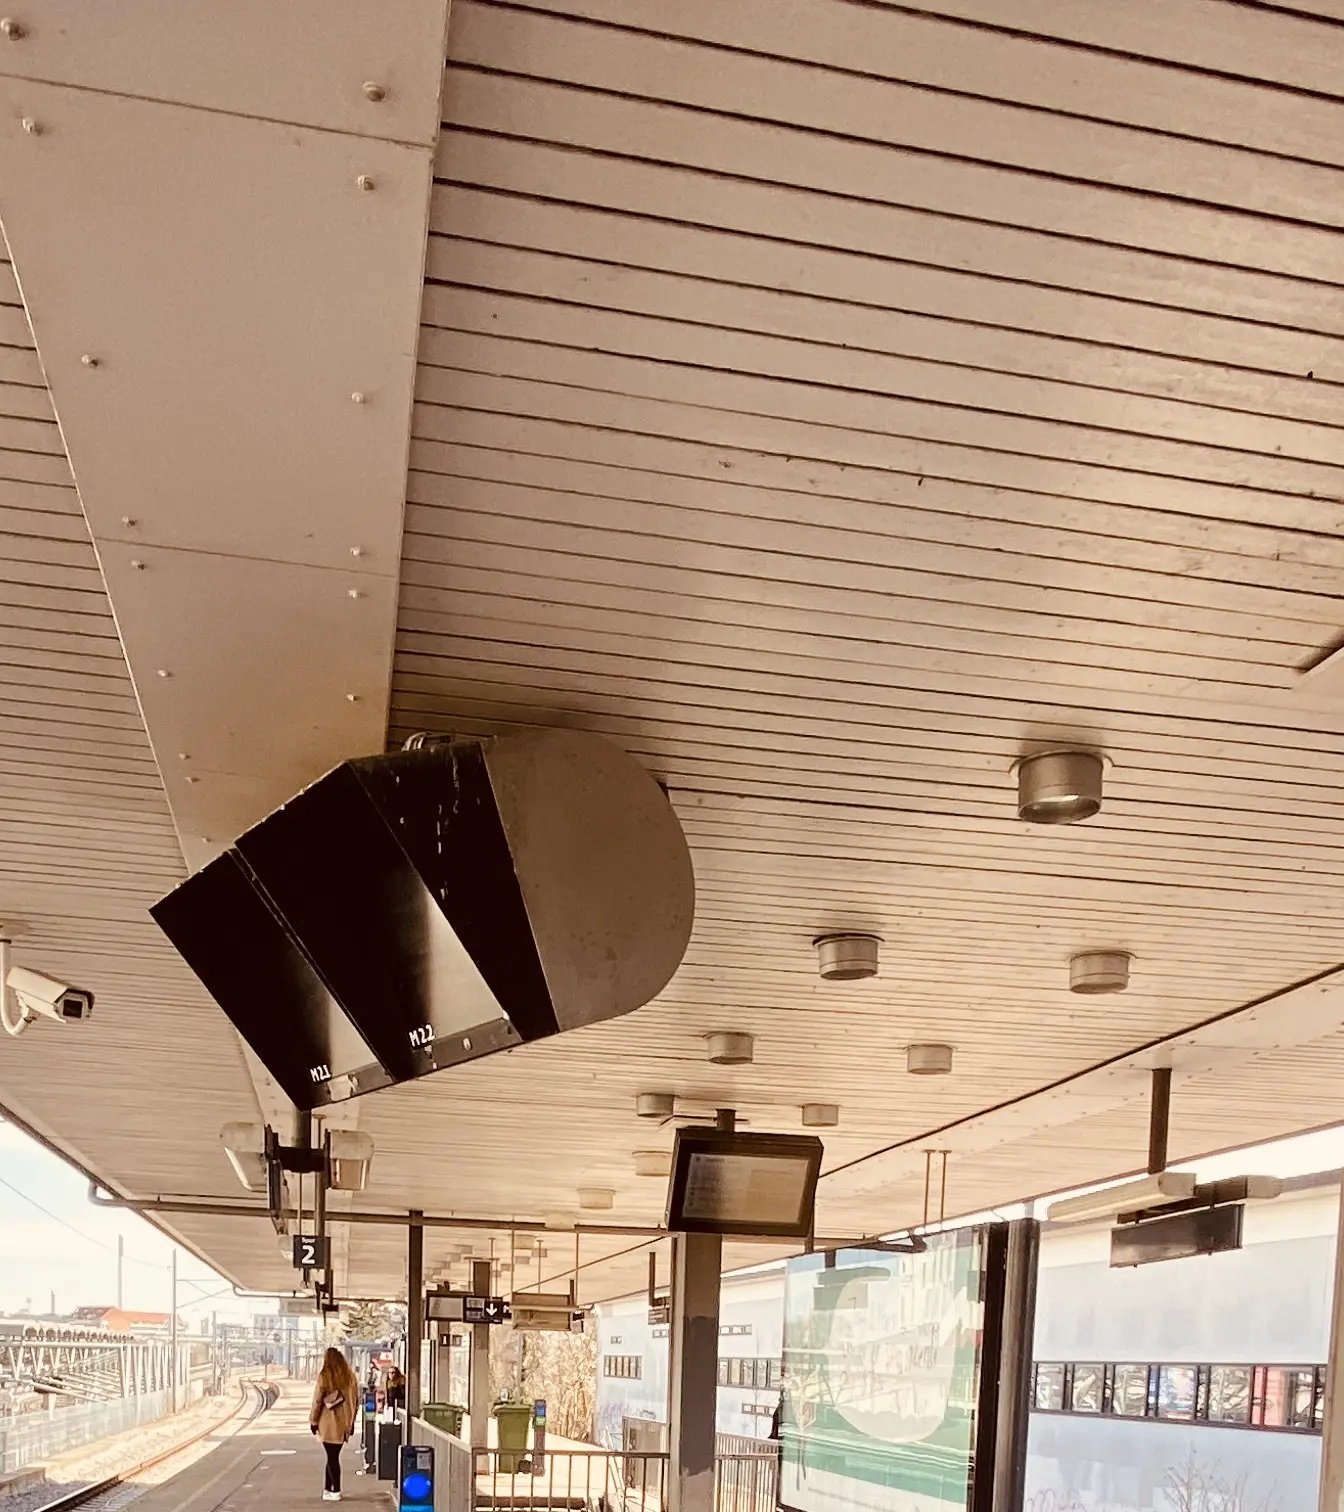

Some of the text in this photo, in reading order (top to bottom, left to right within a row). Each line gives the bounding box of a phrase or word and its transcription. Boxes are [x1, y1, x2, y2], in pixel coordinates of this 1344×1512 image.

[409, 1024, 435, 1047] M22
[310, 1064, 331, 1082] M21
[301, 1245, 316, 1265] 2
